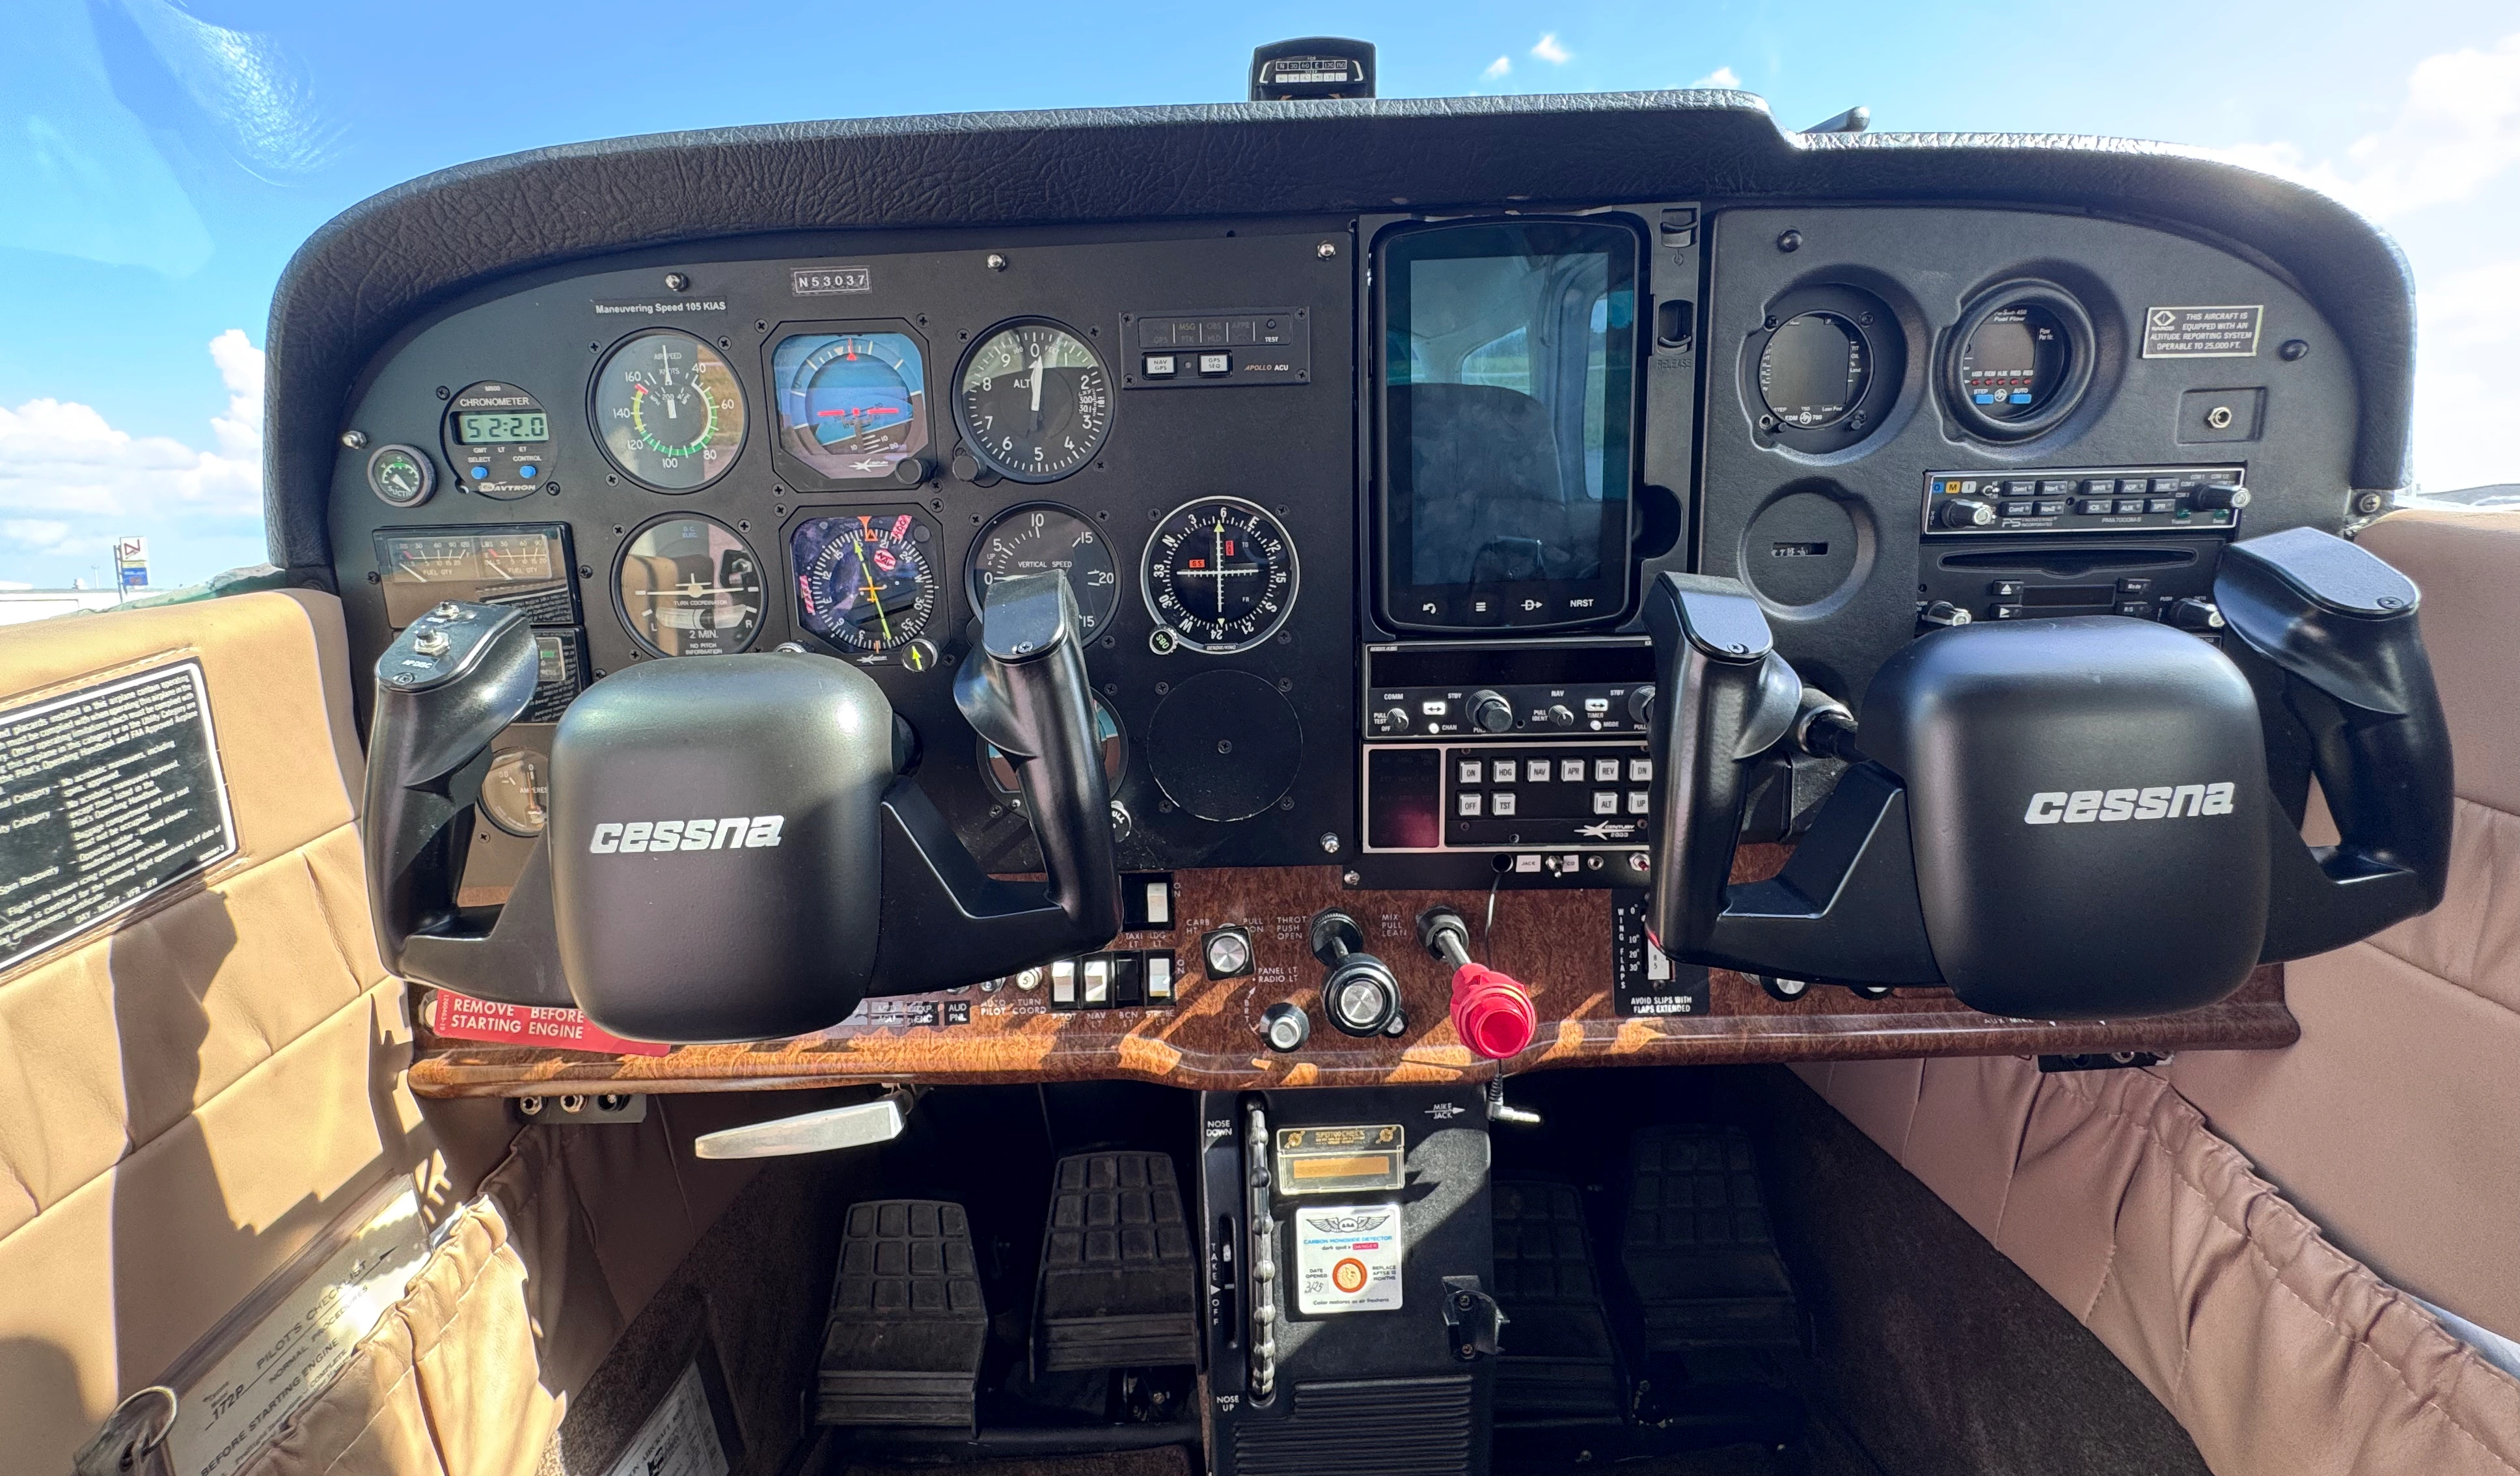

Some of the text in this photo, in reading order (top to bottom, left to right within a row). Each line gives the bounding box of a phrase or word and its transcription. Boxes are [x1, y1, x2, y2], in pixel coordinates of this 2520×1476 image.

[799, 273, 866, 288] N53037
[596, 301, 726, 314] Maneuvering Speed 105 KIAS
[2182, 323, 2215, 331] EQUIPPED
[1030, 343, 1040, 357] 0
[1001, 353, 1011, 368] 9
[1656, 359, 1691, 369] RELEASE
[691, 362, 706, 373] 40
[1274, 363, 1289, 372] ACU
[625, 371, 641, 381] 160
[982, 377, 992, 391] 8
[1013, 379, 1031, 389] ALT
[1080, 375, 1089, 390] 2
[459, 397, 530, 407] CHRONOMETER
[721, 400, 735, 409] 60
[613, 408, 631, 418] 140
[984, 416, 993, 430] 7
[1082, 415, 1092, 429] 3
[627, 439, 643, 450] 120
[1002, 436, 1013, 450] 6
[1064, 436, 1075, 450] 4
[703, 450, 717, 460] 80
[1034, 447, 1044, 461] 5
[662, 458, 678, 468] 100
[1031, 513, 1045, 527] 10
[1081, 532, 1093, 544] 15
[993, 538, 1002, 552] 5
[984, 571, 993, 585] 0
[1099, 572, 1114, 584] 20
[1570, 599, 1594, 608] NRST
[1083, 616, 1095, 627] 15
[689, 630, 719, 639] 2 MIN.
[1155, 633, 1170, 649] OBS
[1466, 769, 1475, 777] ON
[74, 877, 158, 924] DAY NIGHT VFR IFR
[1276, 916, 1308, 924] THROT
[1276, 932, 1303, 940] OPEN
[1381, 929, 1408, 937] LEAN
[1289, 974, 1298, 983] LT
[454, 998, 514, 1016] REMOVE
[530, 1007, 584, 1024] BEFORE
[948, 1003, 967, 1012] AUD
[981, 1007, 1006, 1016] PILOT
[1012, 1007, 1047, 1015] COORD
[1634, 1004, 1691, 1014] FLAPS EXTENDED
[949, 1013, 968, 1022] PNL
[1119, 1011, 1139, 1019] BCN
[450, 1015, 584, 1039] STARTING ENGINE
[1433, 1102, 1452, 1111] MIKE
[1207, 1120, 1231, 1128] NOSE
[1206, 1128, 1233, 1137] DOWN
[306, 1260, 368, 1322] CHECKLIST
[1211, 1299, 1220, 1326] OFF
[268, 1345, 310, 1384] NORMAL
[212, 1384, 245, 1421] 172P
[1216, 1395, 1240, 1404] NOSE
[200, 1430, 248, 1476] BEFORE
[249, 1376, 301, 1431] STARTING
[301, 1337, 339, 1377] ENGINE
